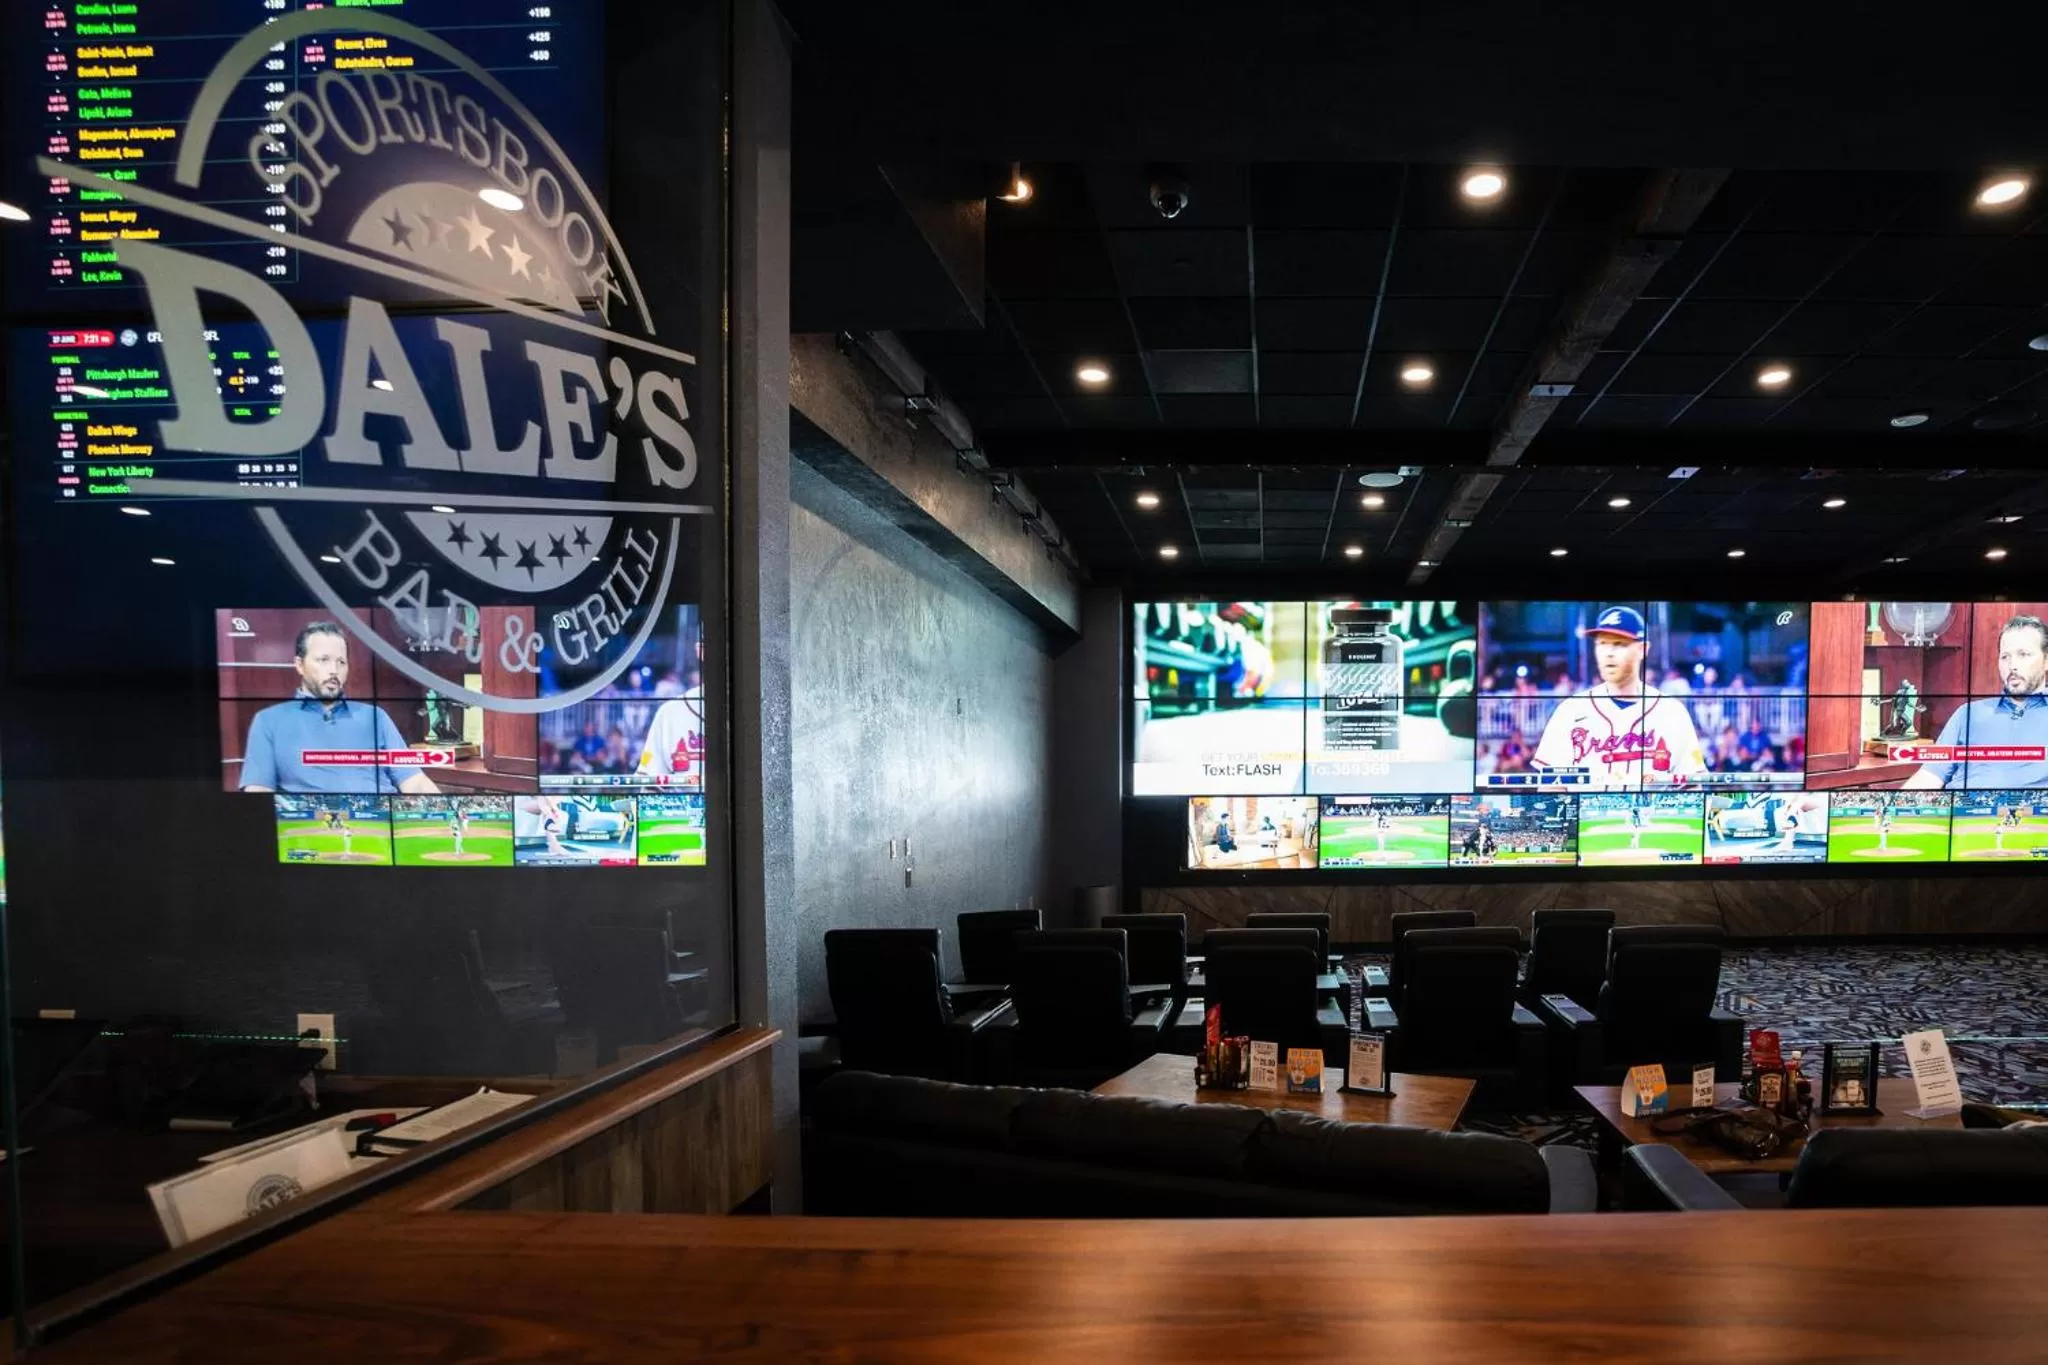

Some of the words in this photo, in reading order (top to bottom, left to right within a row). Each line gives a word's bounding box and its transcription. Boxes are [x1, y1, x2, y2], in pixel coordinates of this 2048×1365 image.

[249, 69, 628, 326] SPORTSBOOK
[82, 271, 100, 283] Lee,
[100, 270, 122, 281] Kevin
[111, 237, 699, 491] DALE'S
[86, 369, 127, 383] Pittsburgh
[135, 387, 169, 398] Stallions
[87, 425, 112, 437] Dallas
[112, 424, 138, 438] Wings
[87, 444, 121, 456] Phoenix
[121, 443, 153, 458] Mercury
[88, 466, 108, 478] New
[109, 466, 127, 477] York
[127, 465, 154, 479] Liberty
[335, 509, 481, 663] BAR
[500, 615, 543, 673] &
[554, 527, 659, 665] GRILL
